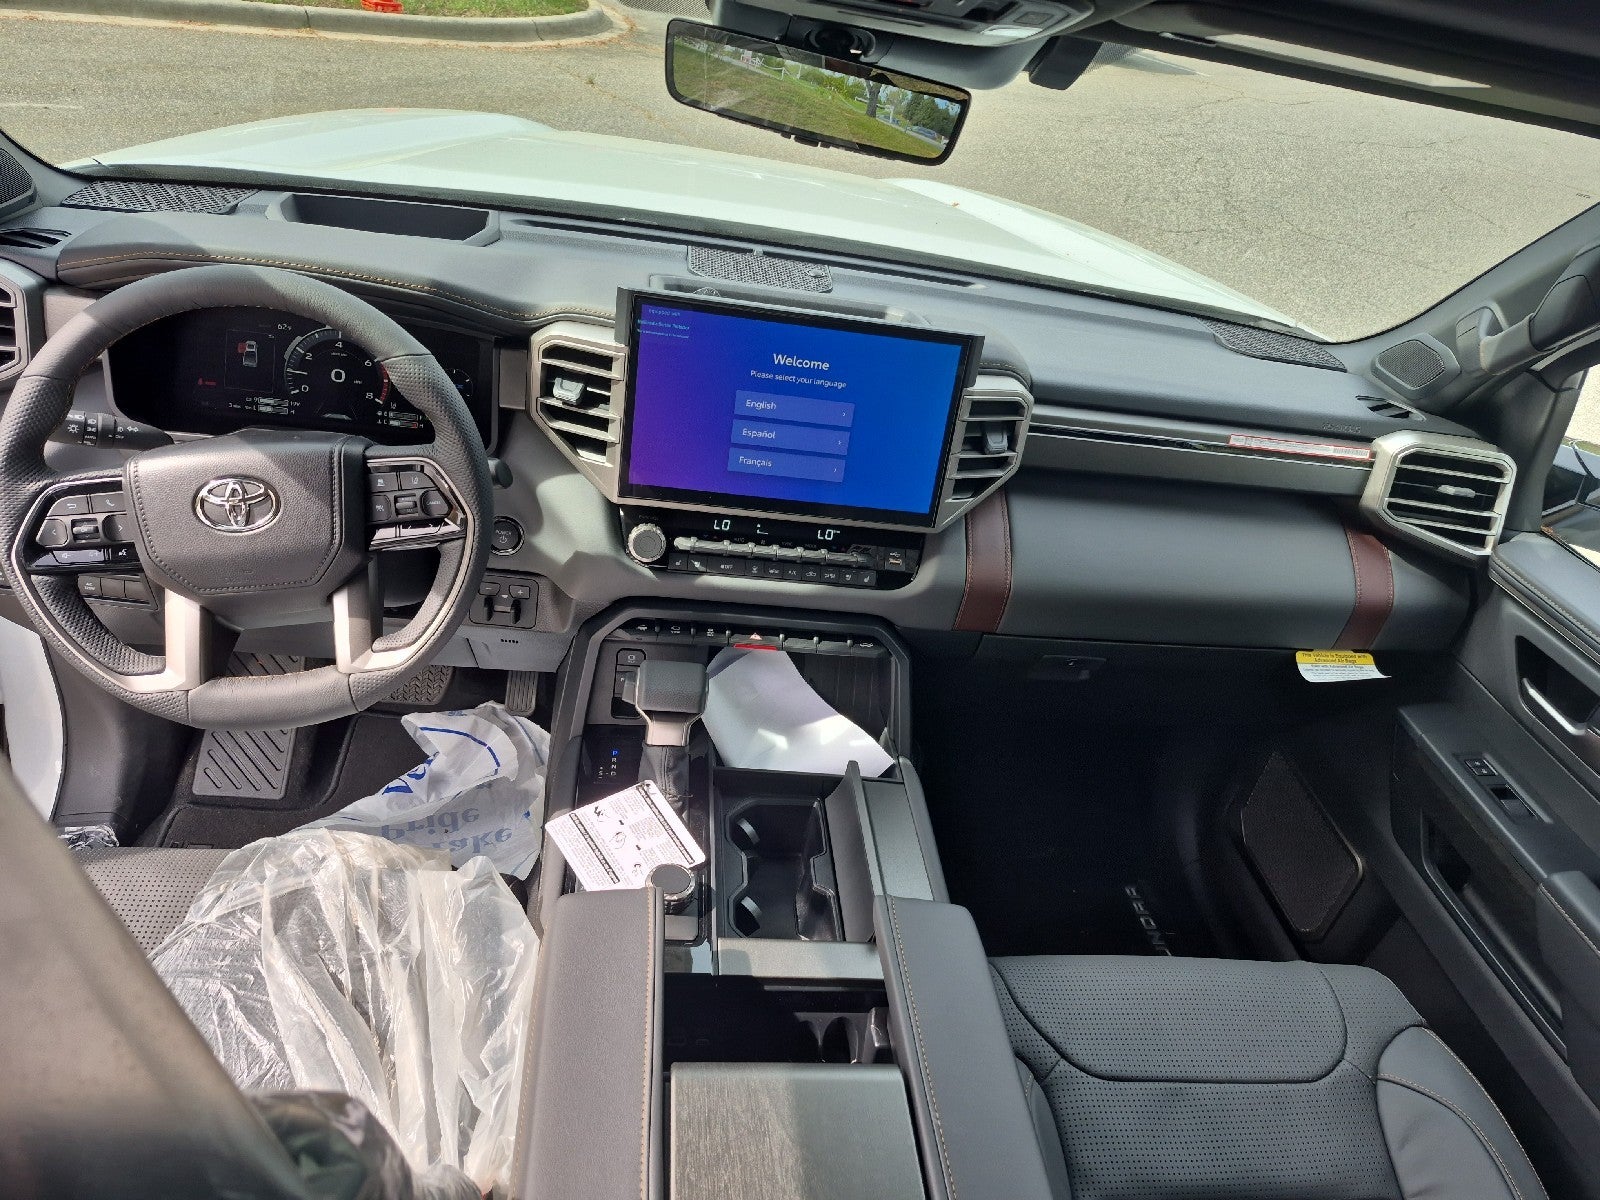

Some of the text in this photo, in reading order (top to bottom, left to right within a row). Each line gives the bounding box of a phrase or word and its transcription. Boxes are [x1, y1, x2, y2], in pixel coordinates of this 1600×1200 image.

[305, 352, 313, 360] 2
[773, 353, 830, 371] Welcome
[364, 359, 372, 367] 6
[330, 368, 346, 383] 0
[750, 369, 847, 390] Please select your language
[301, 384, 309, 392] 0
[745, 399, 777, 411] English
[742, 427, 776, 439] Español
[739, 456, 772, 468] Français
[713, 519, 731, 531] LO
[817, 528, 834, 541] LO
